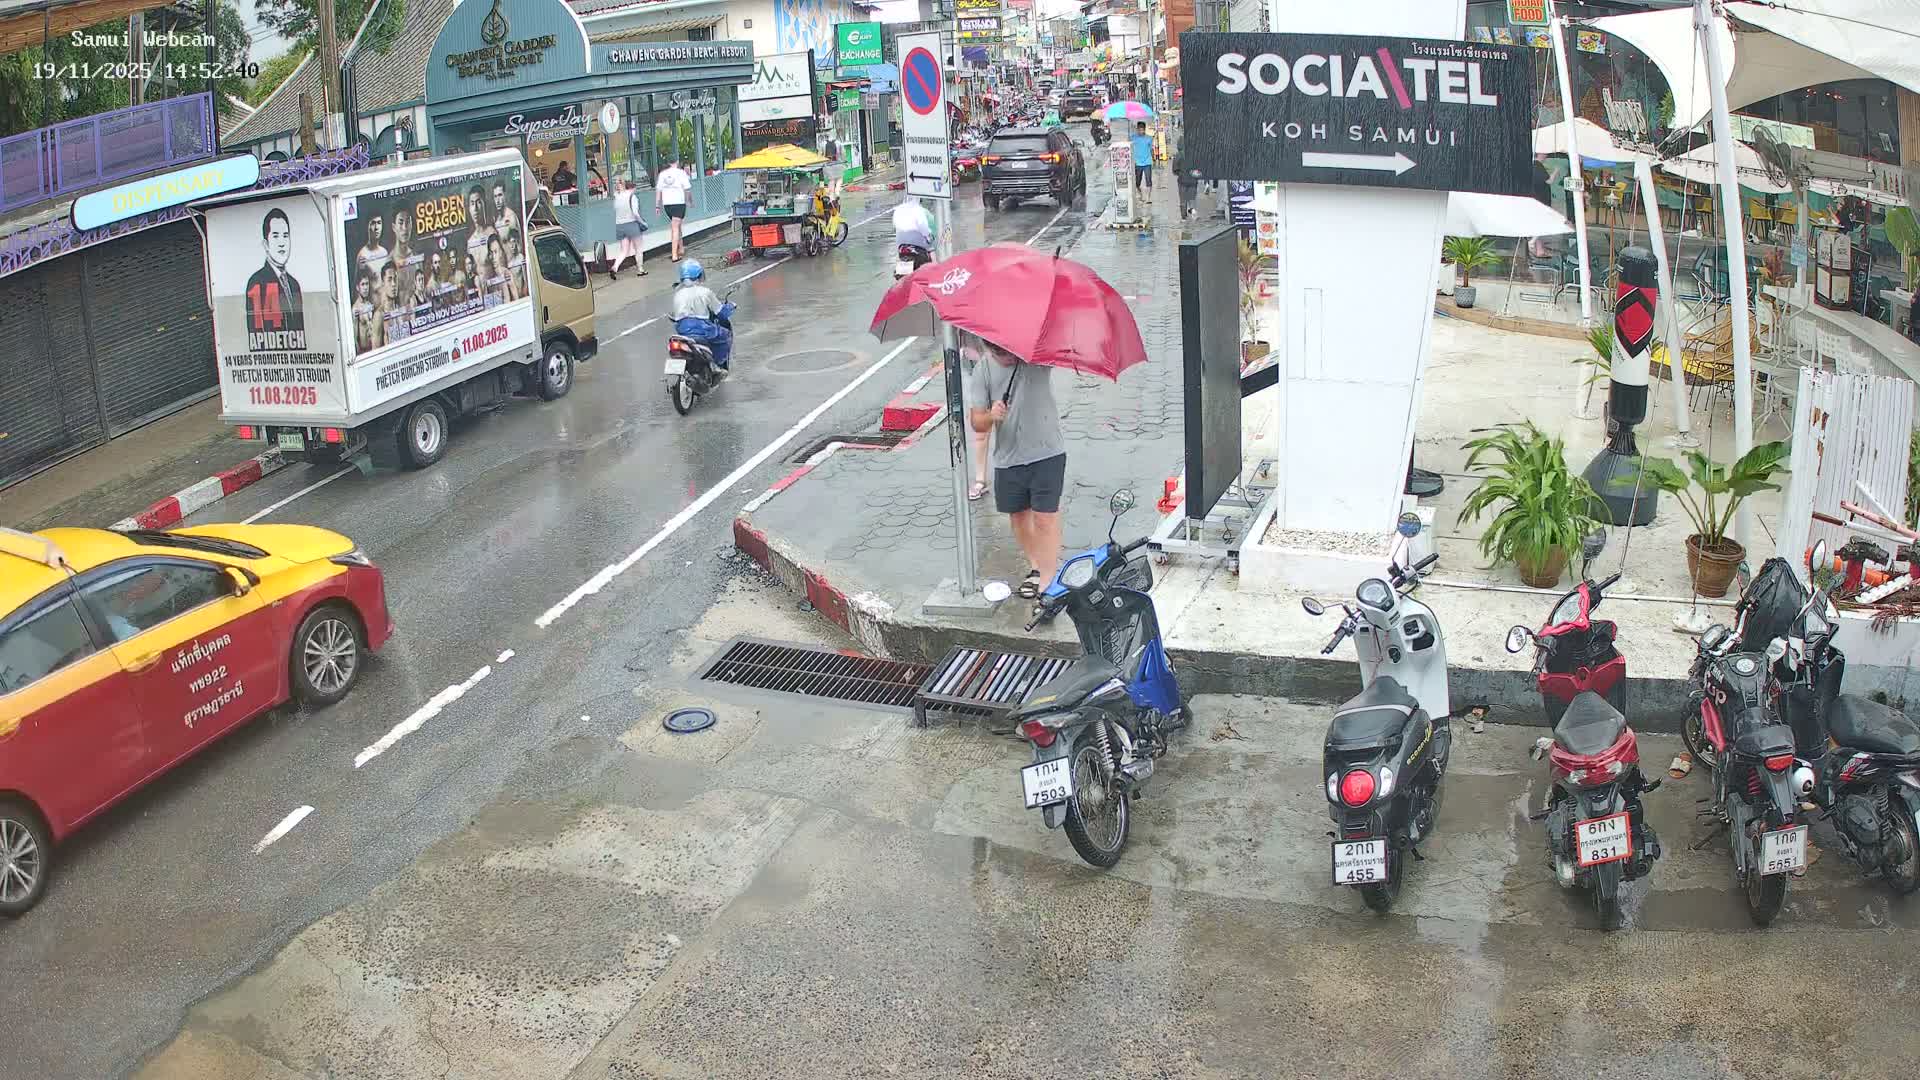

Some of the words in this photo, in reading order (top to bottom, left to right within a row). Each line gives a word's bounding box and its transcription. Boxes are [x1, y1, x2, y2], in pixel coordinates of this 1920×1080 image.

[1514, 8, 1543, 21] FOOD
[611, 48, 656, 63] CHAWENG
[658, 47, 692, 61] GARDEN
[693, 46, 719, 59] BEACH
[721, 46, 748, 57] RESORT
[840, 49, 881, 60] EXCHANGE
[1411, 43, 1509, 61] โรงแรมโซเชียลเทล
[1262, 122, 1327, 140] KOH
[1349, 124, 1456, 147] SAMUI
[910, 155, 918, 164] NO
[919, 155, 943, 165] PARKING
[111, 169, 225, 213] DISPENSARY
[373, 191, 388, 200] THE
[390, 188, 408, 197] BEST
[410, 183, 430, 192] MUAY
[430, 180, 447, 190] THAI
[448, 176, 468, 186] FIGHT
[416, 194, 465, 218] GOLDEN
[416, 208, 467, 235] DRAGON
[246, 282, 284, 329] 14
[411, 316, 427, 328] WED
[435, 307, 451, 320] NOV
[249, 330, 306, 351] APIDETCH
[461, 324, 508, 355] 11.08.2025
[225, 354, 232, 366] 14
[232, 353, 253, 366] YEARS
[254, 352, 289, 365] PROMOTER
[290, 352, 335, 366] ANNIVERSARY
[232, 368, 263, 384] PHETCH
[296, 367, 331, 384] STADIUM
[376, 371, 401, 391] PHETCH
[425, 351, 450, 372] STADIUM
[249, 386, 317, 406] 11.08.2025
[1032, 786, 1067, 804] 7503
[1592, 846, 1617, 861] 831
[1768, 856, 1797, 872] 5651
[1347, 868, 1375, 882] 455
